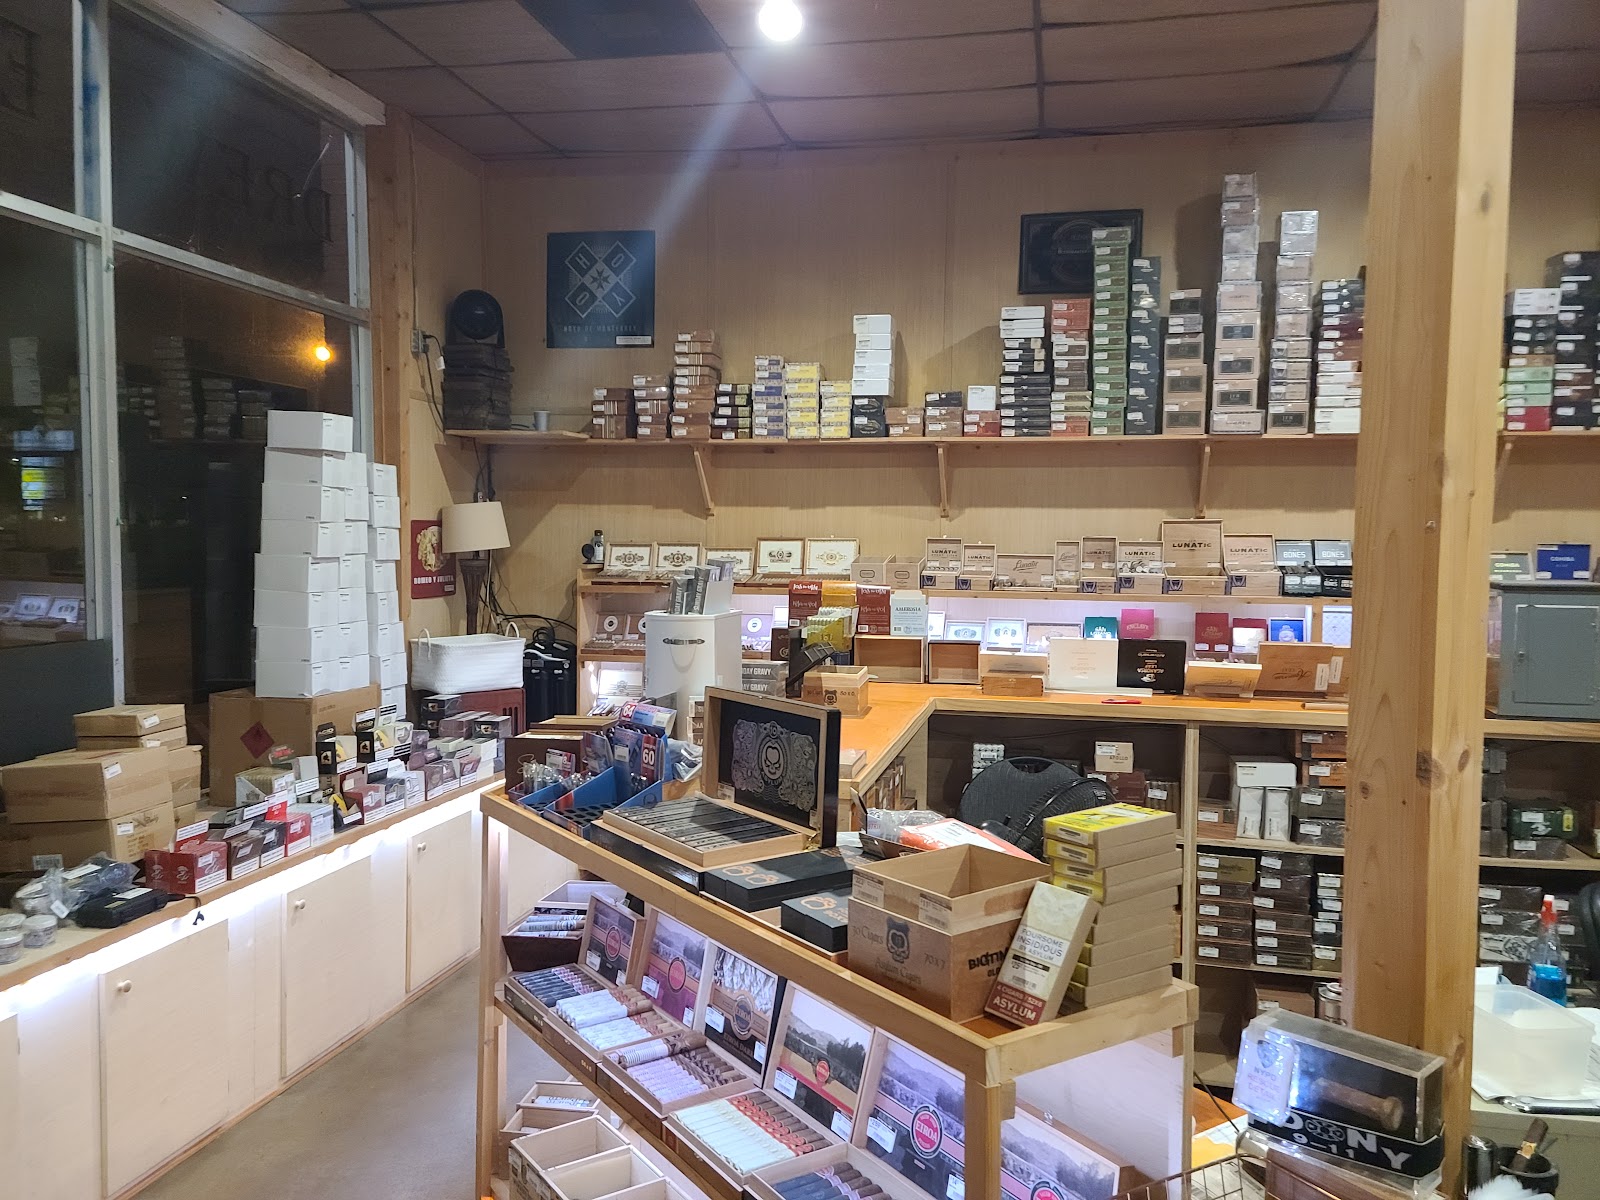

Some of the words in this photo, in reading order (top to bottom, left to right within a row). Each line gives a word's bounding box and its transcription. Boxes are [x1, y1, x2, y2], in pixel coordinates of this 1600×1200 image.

[1283, 551, 1306, 559] BONES
[413, 576, 432, 585] ROMEO
[753, 667, 771, 675] GRAVY
[623, 705, 635, 718] 64
[642, 749, 655, 765] 60
[861, 925, 884, 946] Cigars
[1022, 928, 1064, 948] FOURSOME
[1017, 935, 1063, 957] INSIDIOUS
[1028, 948, 1054, 961] ASYLUM
[993, 996, 1036, 1020] ASYLUM
[1254, 1067, 1277, 1081] NYPD
[915, 1121, 938, 1143] EIROA
